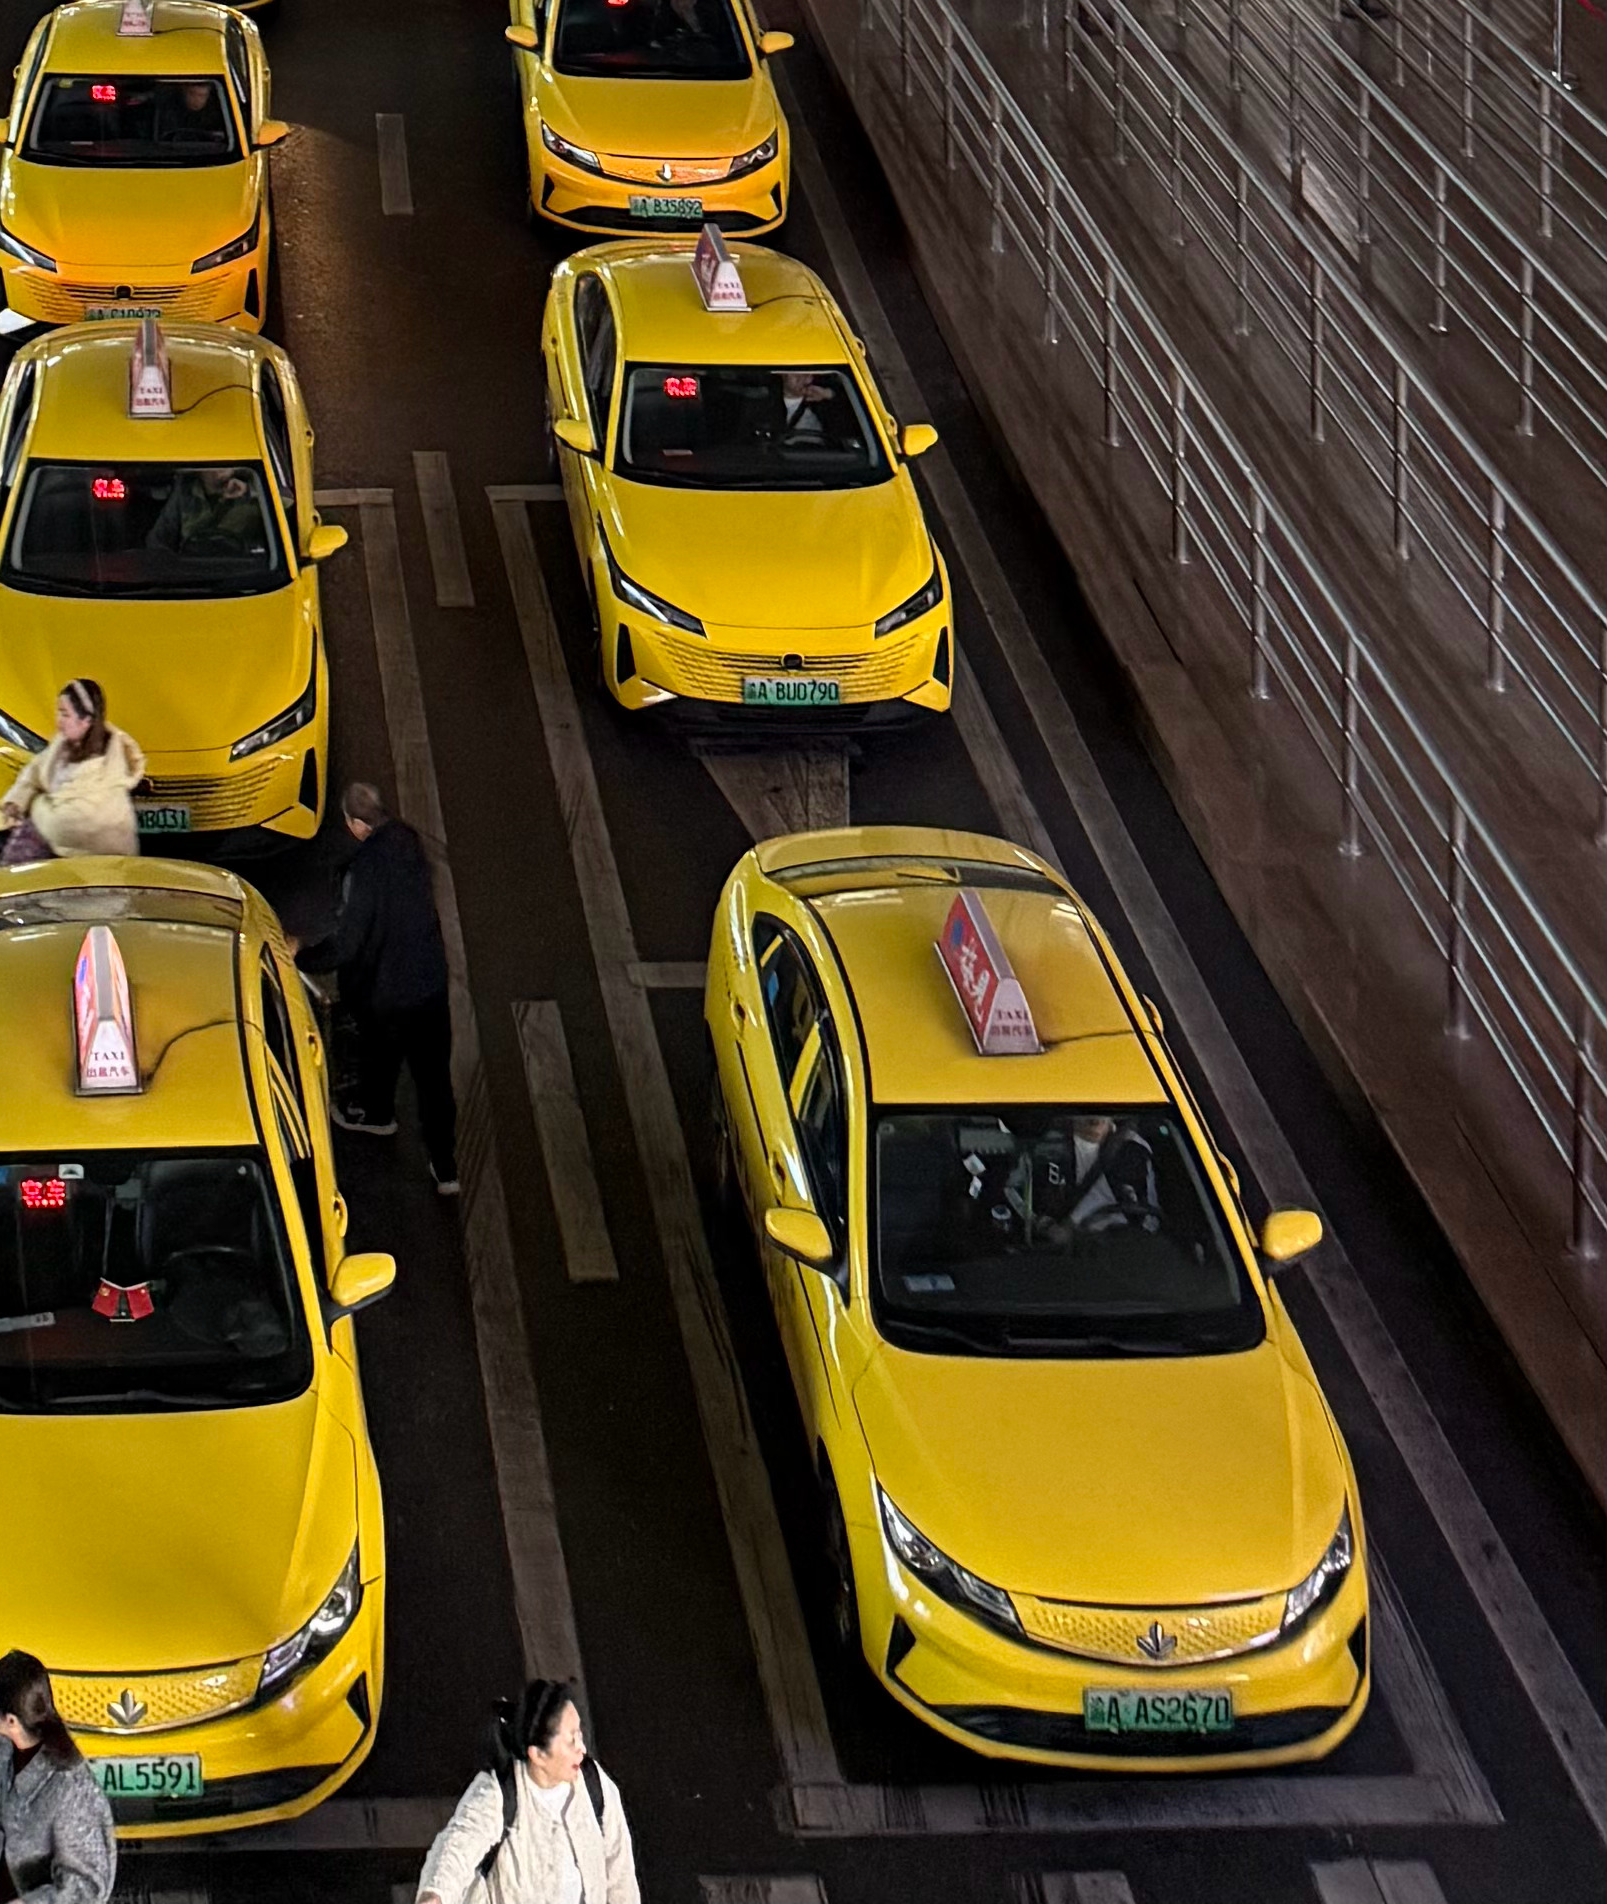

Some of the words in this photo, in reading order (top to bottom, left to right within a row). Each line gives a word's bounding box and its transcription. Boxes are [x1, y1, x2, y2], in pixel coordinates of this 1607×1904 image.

[995, 1009, 1028, 1020] TAXI
[93, 1051, 125, 1061] TAXI
[1135, 1696, 1229, 1724] AS2670
[103, 1761, 196, 1790] AL5591
